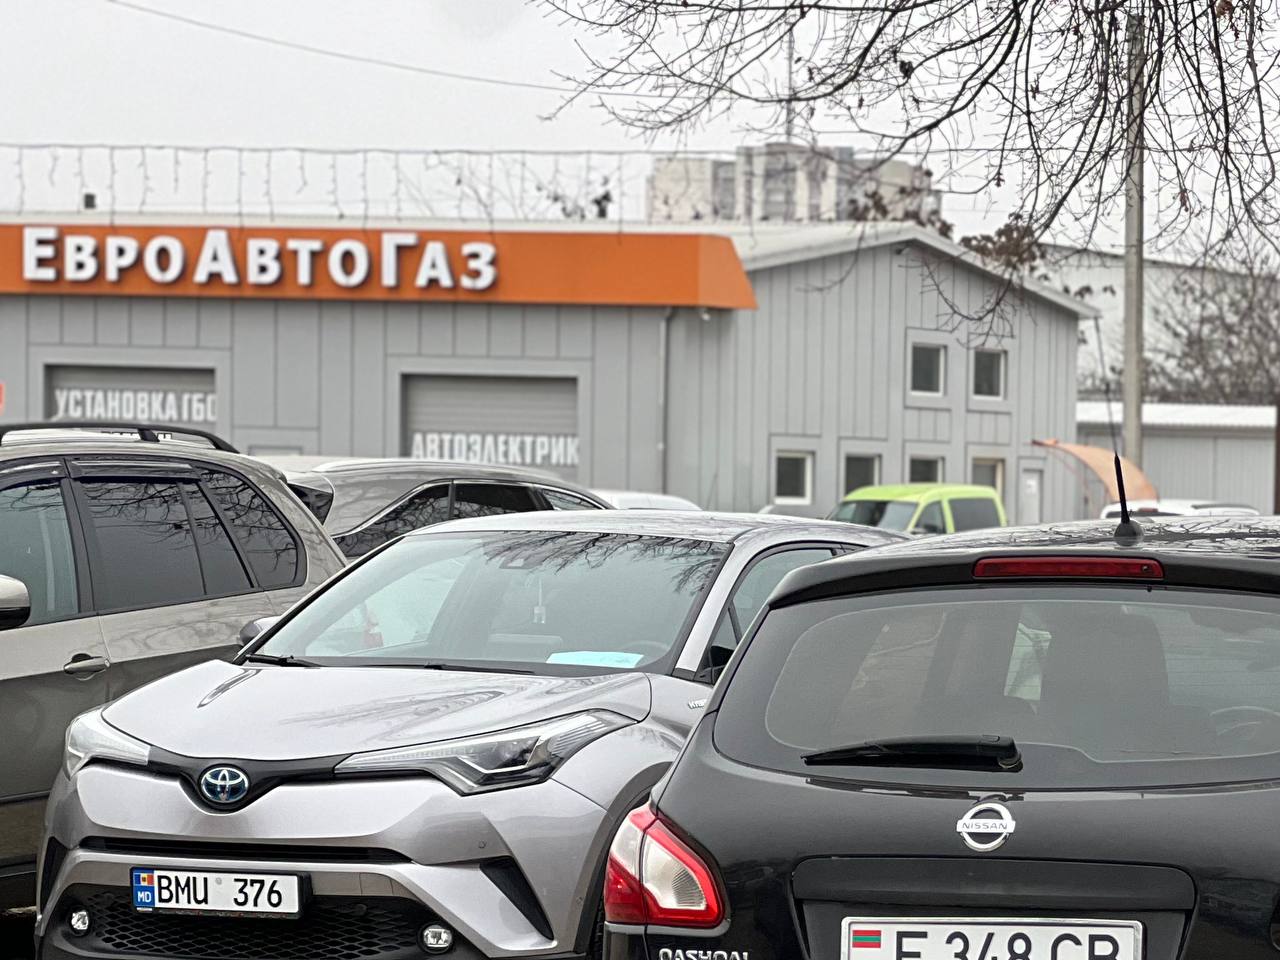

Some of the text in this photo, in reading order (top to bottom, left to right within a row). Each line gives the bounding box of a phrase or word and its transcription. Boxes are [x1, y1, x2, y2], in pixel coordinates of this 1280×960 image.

[50, 389, 178, 422] УСТАНОВКА
[962, 822, 1008, 831] NISSAN
[137, 891, 152, 903] MD
[157, 875, 282, 908] BMU 376
